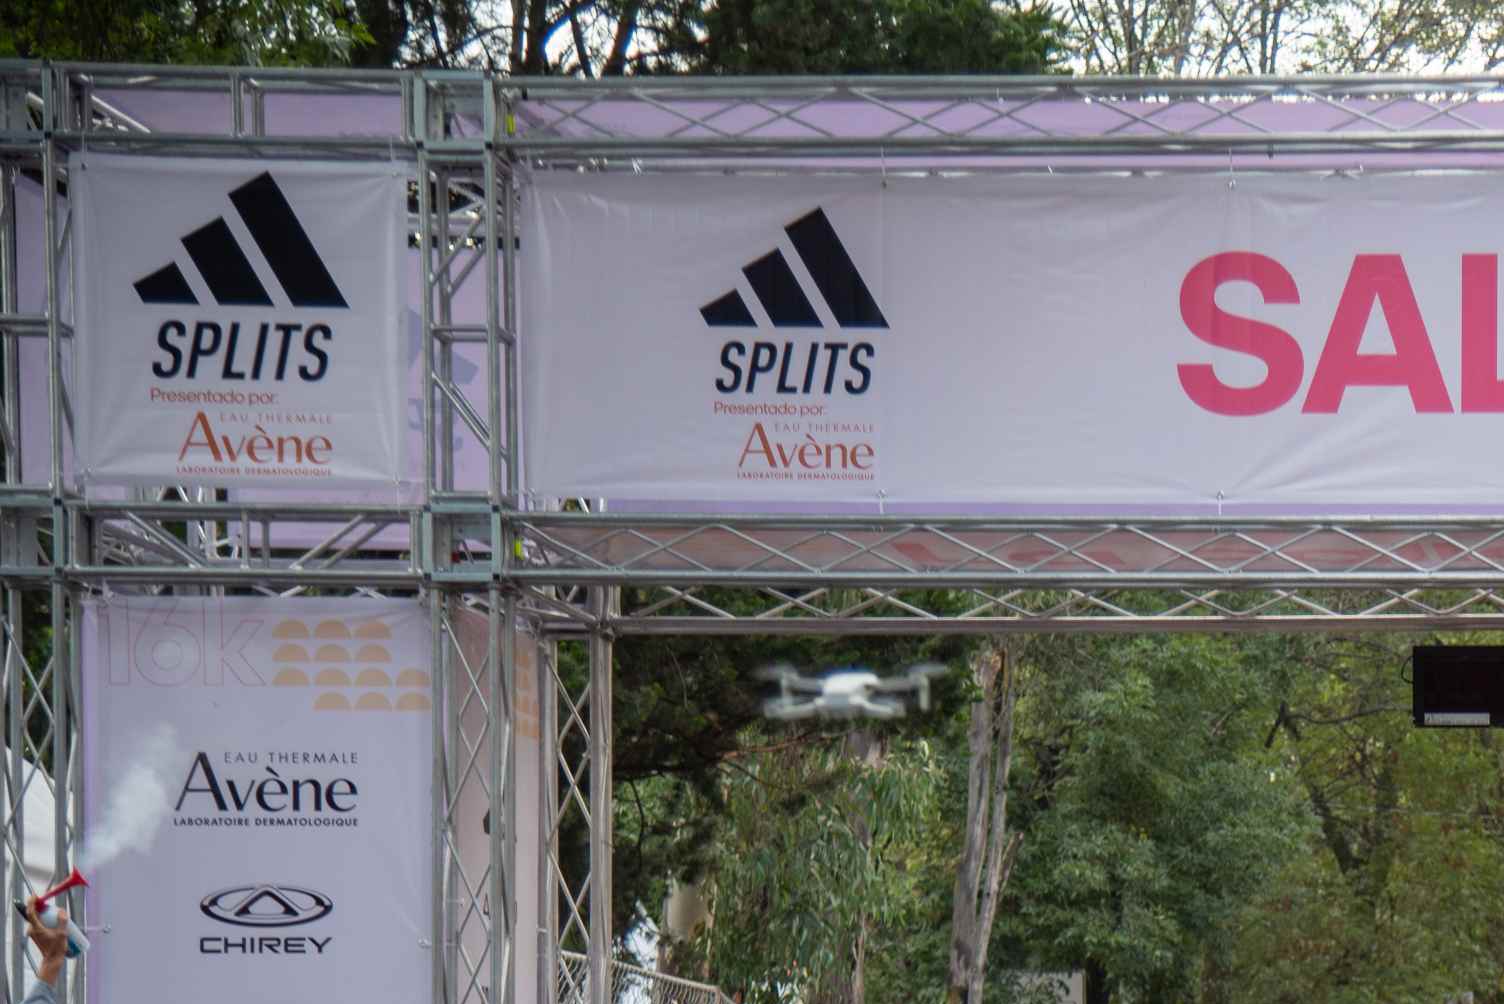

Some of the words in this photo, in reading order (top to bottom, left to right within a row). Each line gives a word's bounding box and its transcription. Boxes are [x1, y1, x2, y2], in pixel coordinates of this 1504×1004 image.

[151, 320, 333, 381] SPLITS
[715, 341, 875, 395] SPLITS
[150, 388, 245, 404] Presentado
[714, 401, 797, 415] Presentado
[220, 413, 248, 424] EAU
[259, 413, 333, 424] THERMALE
[774, 423, 800, 433] EAU
[808, 423, 875, 433] THERMALE
[178, 410, 333, 465] Avène
[738, 421, 875, 470] Avène
[224, 752, 258, 764] EAU
[269, 752, 358, 764] THERMALE
[175, 751, 358, 813] Avène
[173, 817, 250, 827] LABORATOIRE
[254, 817, 358, 828] DERMATOLOGIQUE
[199, 937, 333, 954] CHIREY
